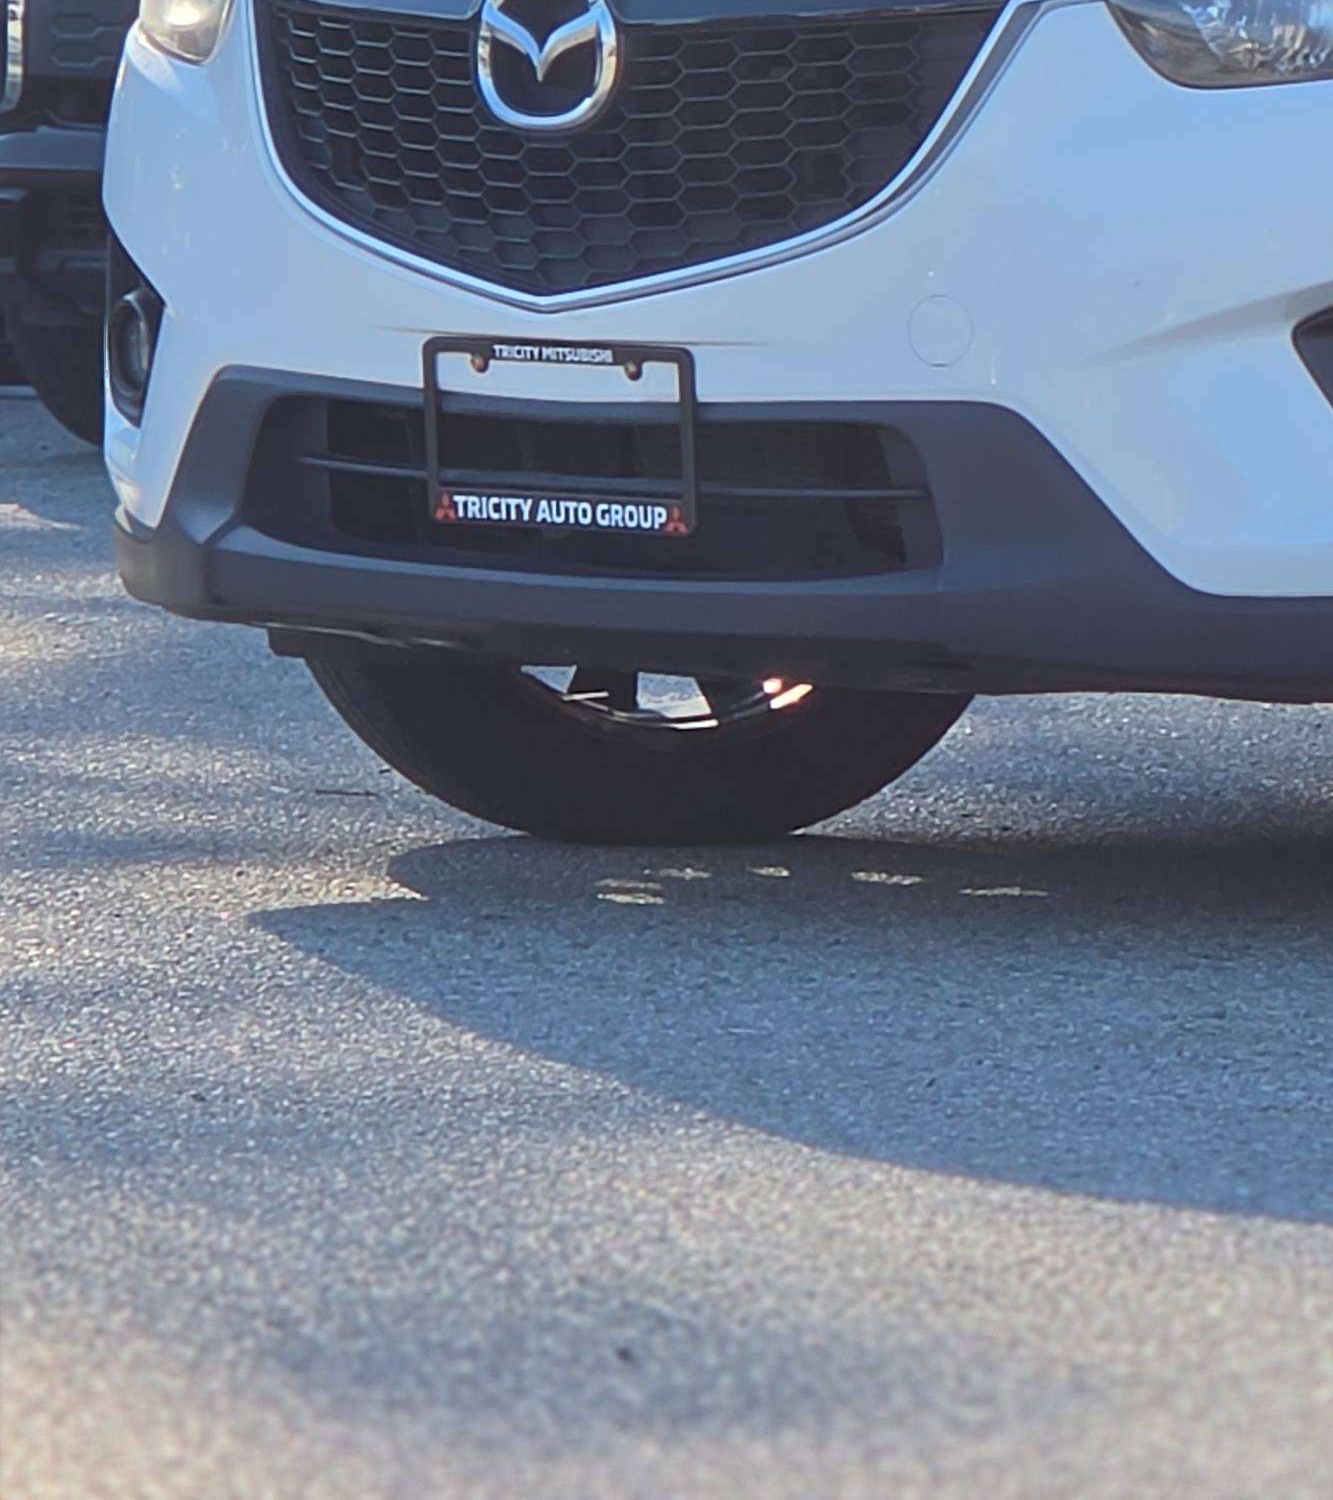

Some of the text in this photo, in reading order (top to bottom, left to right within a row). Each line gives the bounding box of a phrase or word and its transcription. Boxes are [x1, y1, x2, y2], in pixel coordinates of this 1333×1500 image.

[492, 344, 540, 361] TRICITY
[452, 494, 668, 530] TRICITY AUTO GROUP
